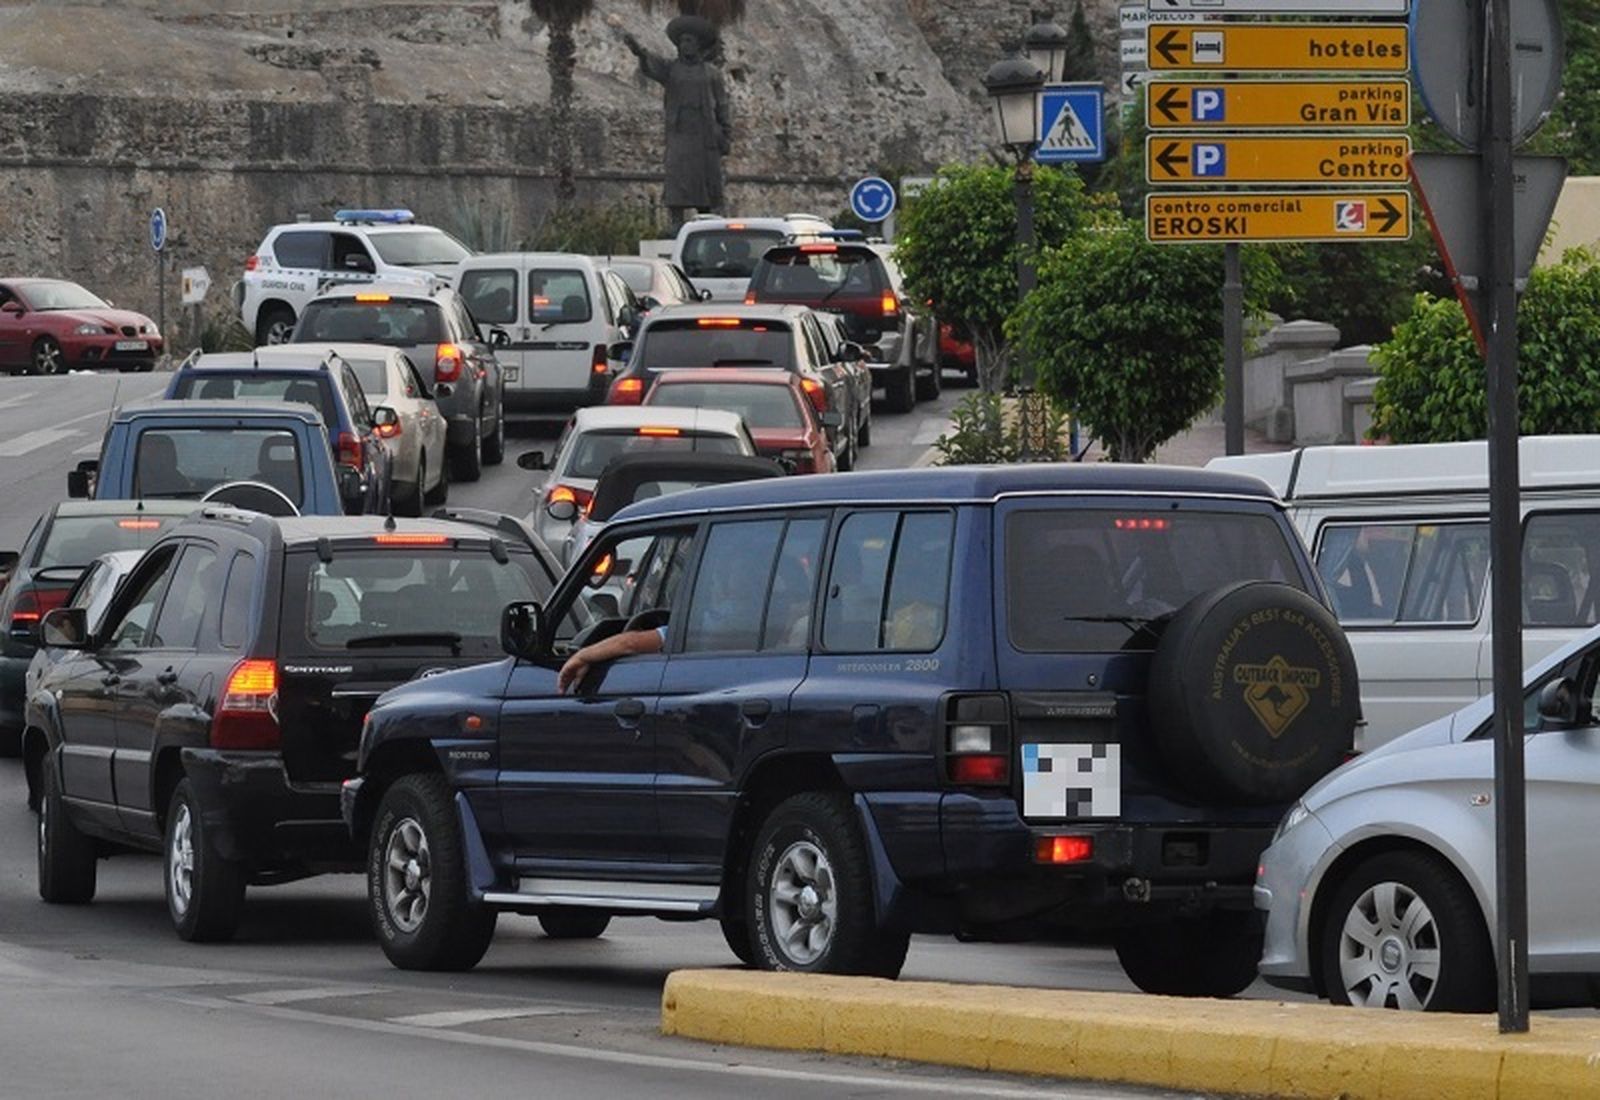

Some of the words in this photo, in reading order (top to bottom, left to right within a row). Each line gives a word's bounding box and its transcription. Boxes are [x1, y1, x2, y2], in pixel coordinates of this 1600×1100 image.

[1309, 39, 1402, 57] hoteles
[1339, 87, 1402, 102] parking
[1196, 90, 1220, 119] P
[1300, 103, 1357, 121] Gran
[1366, 103, 1402, 121] Vía
[1340, 143, 1403, 158] parking
[1196, 145, 1221, 175] P
[1319, 159, 1403, 177] Centro
[1153, 201, 1211, 213] centro
[1217, 199, 1303, 213] comercial
[1154, 217, 1247, 235] EROSKI
[1213, 617, 1250, 699] AUSTRALIA'S
[1251, 608, 1280, 625] BEST
[904, 658, 940, 671] 2800
[1237, 665, 1280, 683] OUTBACK
[448, 751, 491, 760] MONTERO
